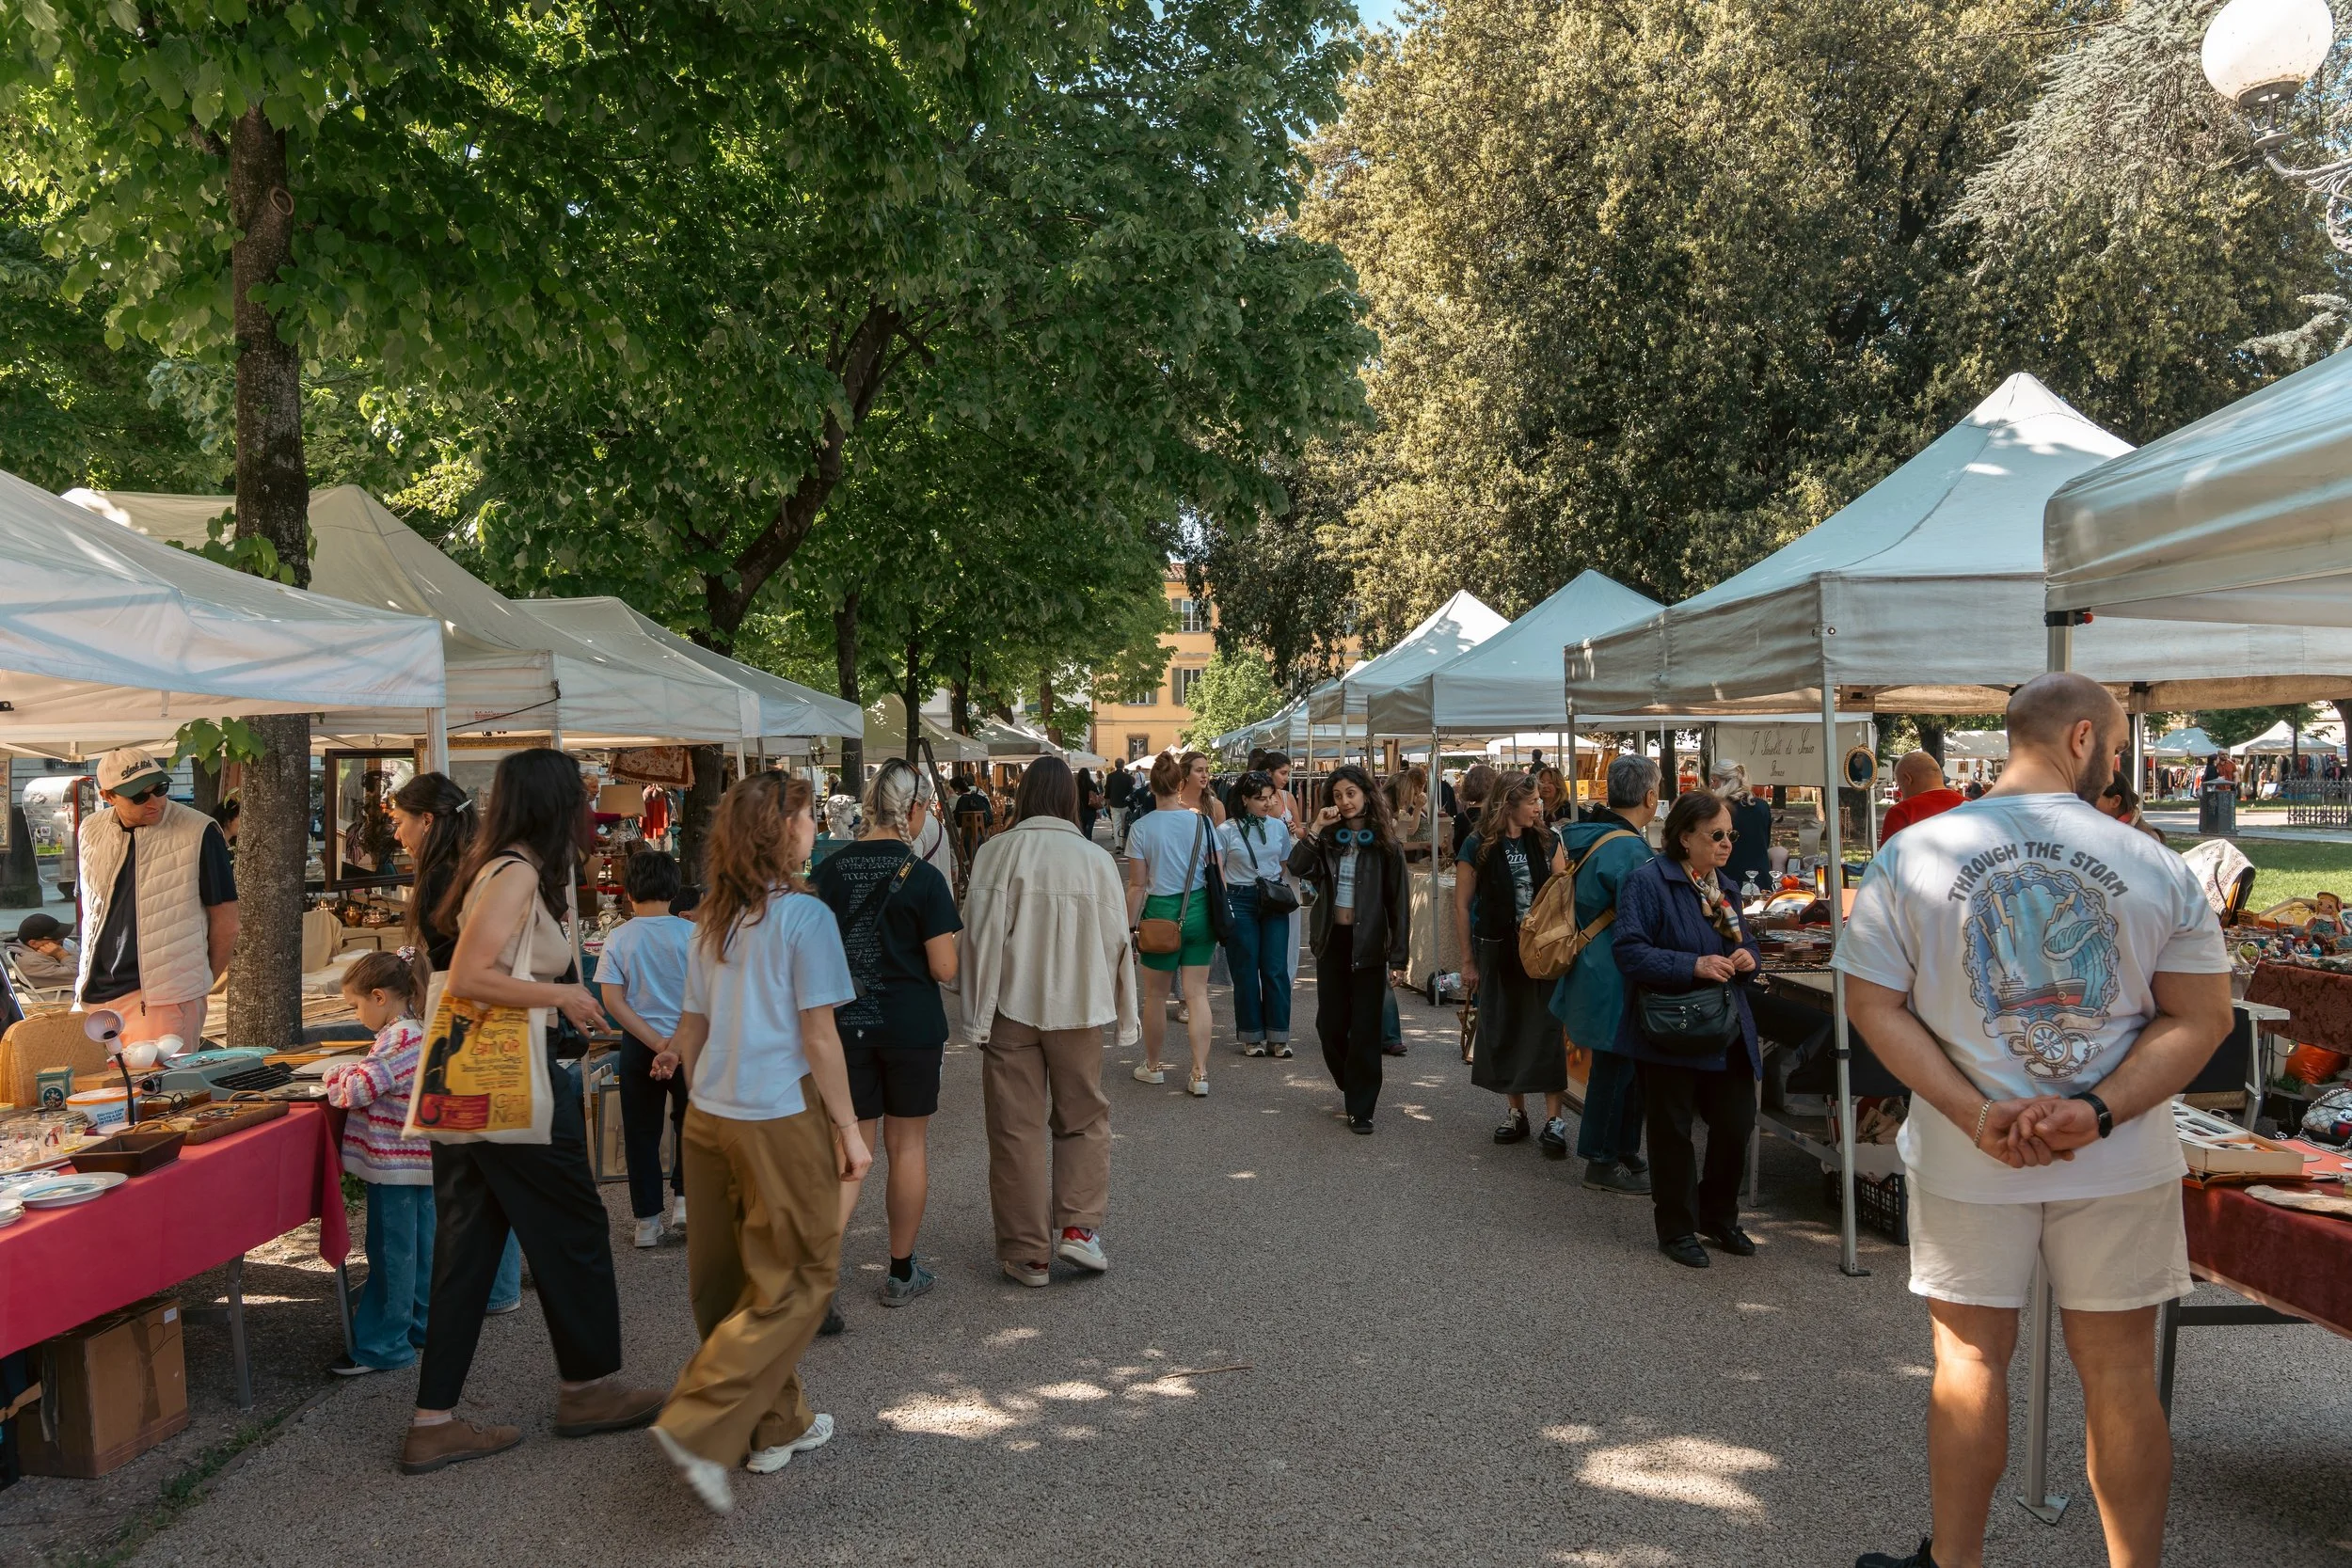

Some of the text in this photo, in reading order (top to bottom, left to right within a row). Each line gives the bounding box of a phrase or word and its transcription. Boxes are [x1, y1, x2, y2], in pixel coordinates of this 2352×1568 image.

[842, 872, 868, 880] TOUR
[899, 862, 912, 879] Nikon
[1947, 841, 2128, 902] THROUGH THE STORM
